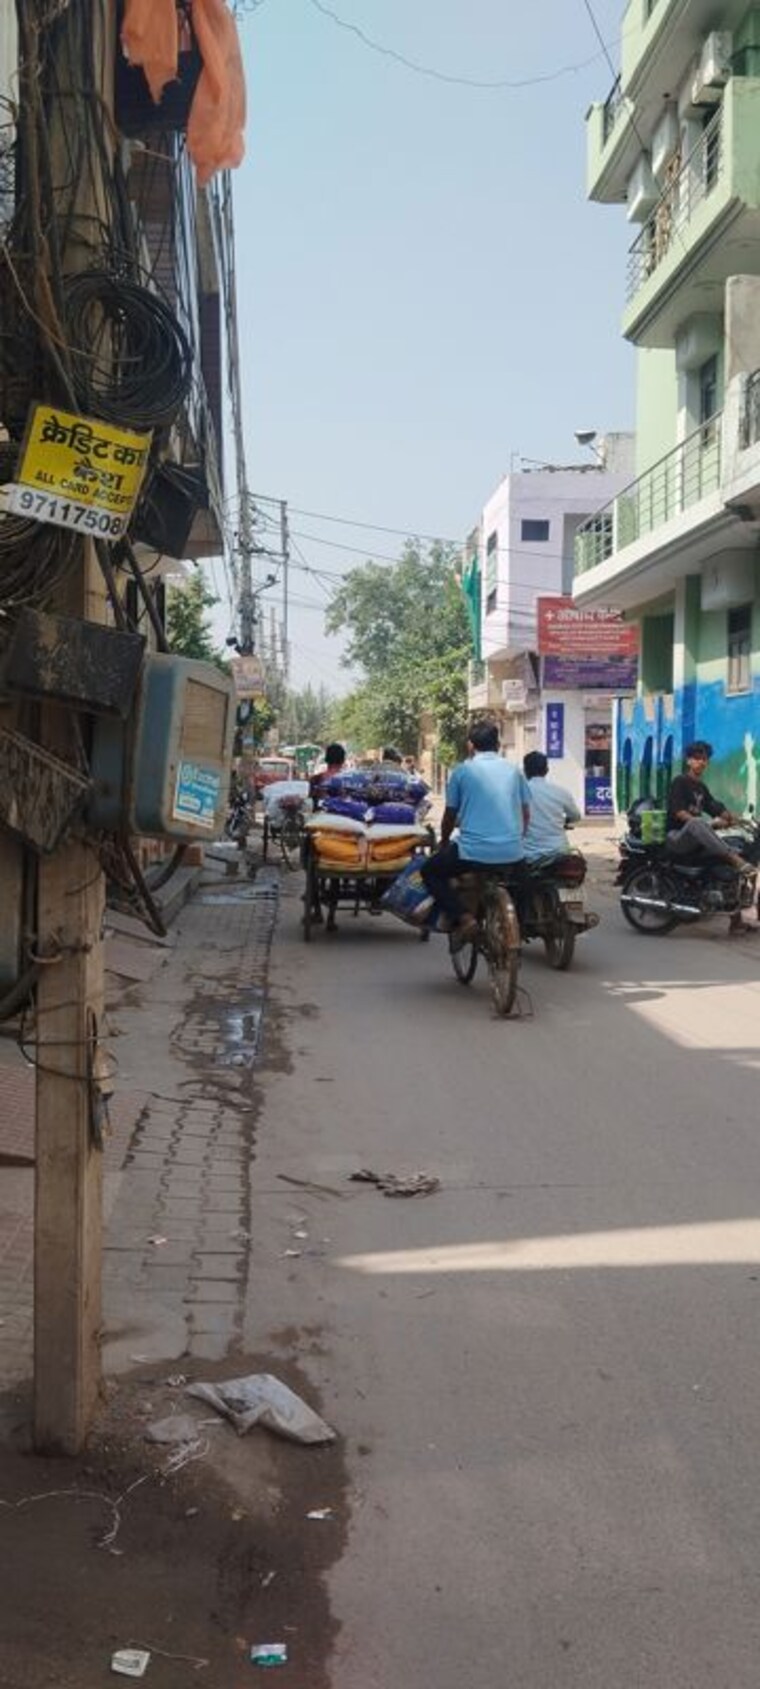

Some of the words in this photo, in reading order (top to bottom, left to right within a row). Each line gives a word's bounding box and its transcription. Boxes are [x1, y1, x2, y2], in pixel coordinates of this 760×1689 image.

[40, 416, 111, 459] क्रेडिट
[35, 470, 55, 485] ALL
[60, 478, 89, 495] CARD
[73, 457, 125, 491] कैश
[20, 492, 121, 535] 97117508
